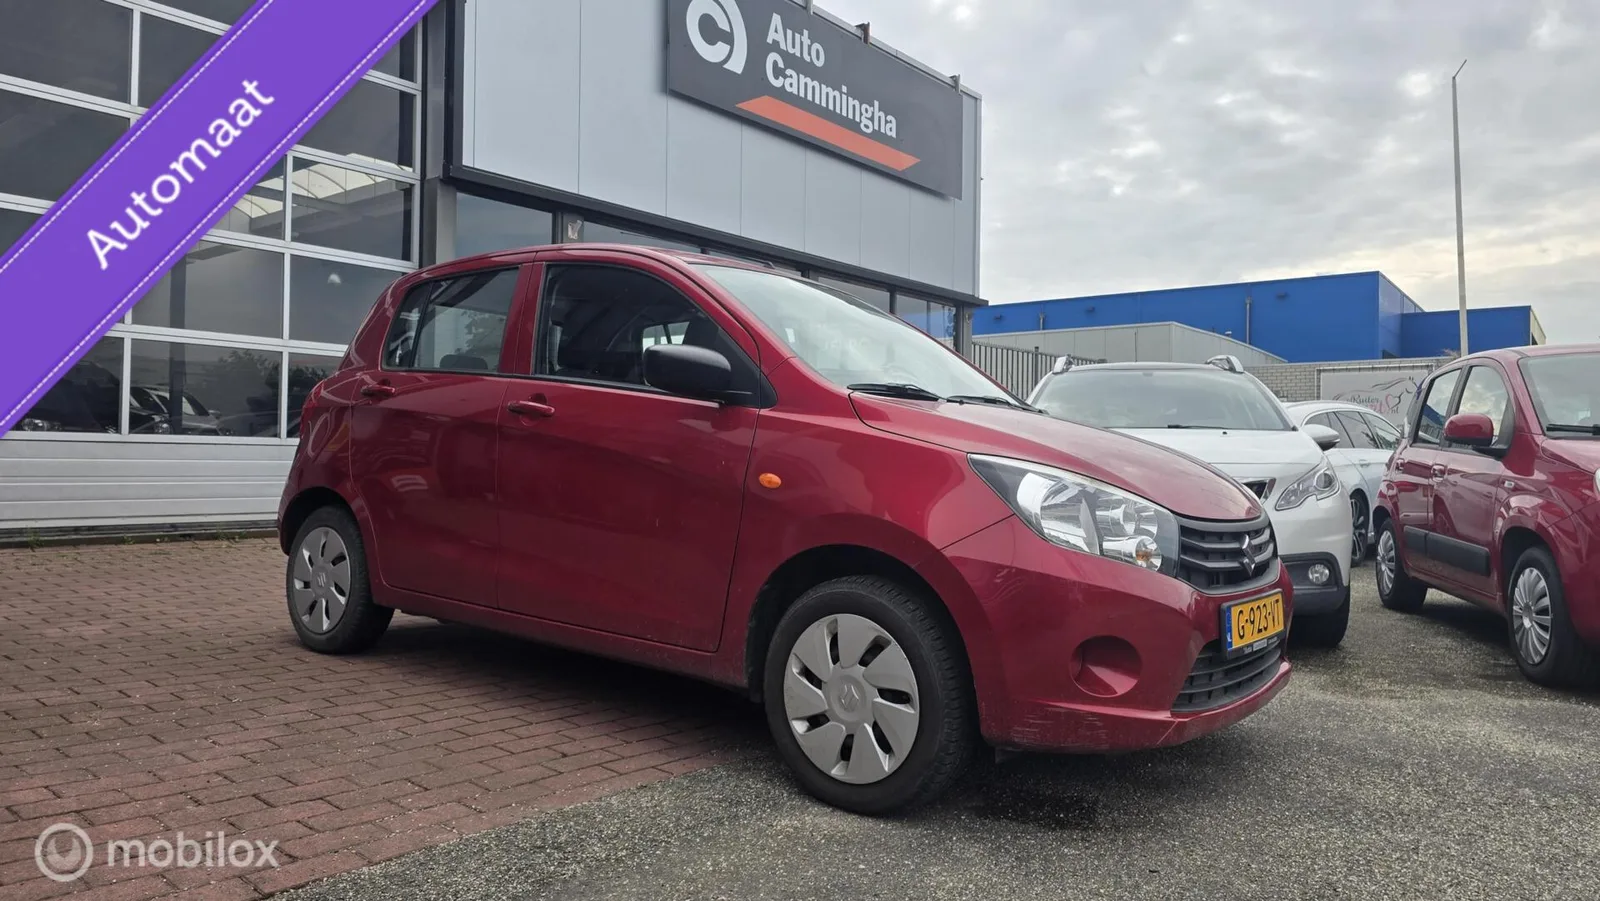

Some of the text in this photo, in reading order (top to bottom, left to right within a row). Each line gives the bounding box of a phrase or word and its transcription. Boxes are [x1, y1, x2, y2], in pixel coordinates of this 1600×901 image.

[766, 12, 825, 67] Auto
[765, 51, 897, 139] Cammingha
[1237, 598, 1280, 640] G-923-VT
